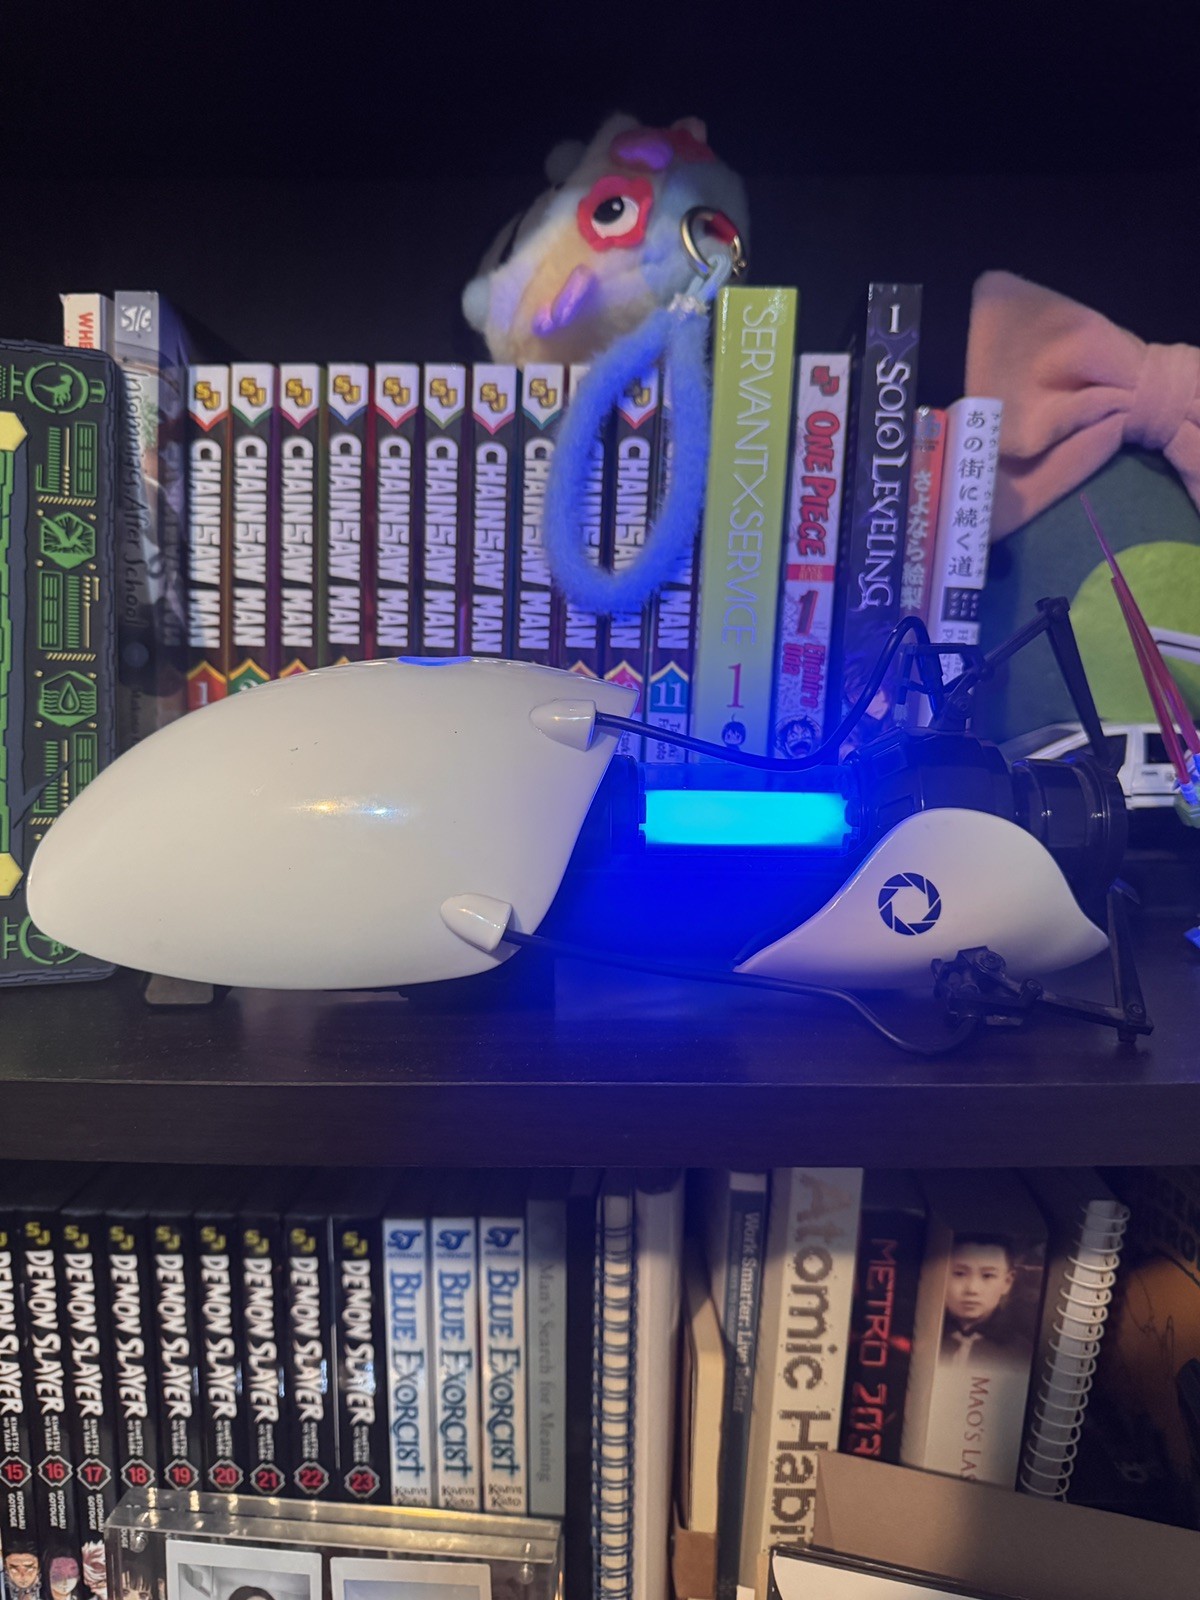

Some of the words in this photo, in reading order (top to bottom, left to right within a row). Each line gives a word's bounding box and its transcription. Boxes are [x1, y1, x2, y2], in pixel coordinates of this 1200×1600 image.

[874, 353, 911, 451] SOLO
[803, 410, 840, 473] ONE
[189, 438, 221, 585] CHAINSAW
[234, 436, 267, 584] CHAINSAW
[281, 436, 313, 584] CHAINSAW
[329, 433, 361, 580] CHAINSAW
[378, 435, 411, 584] CHAINSAW
[425, 437, 458, 585] CHAINSAW
[473, 442, 508, 590] CHAINSAW
[797, 475, 837, 558] PIECE
[947, 410, 986, 578] あの街に続く道
[857, 452, 908, 612] LEVELING
[123, 551, 147, 628] School
[189, 587, 220, 649] MAN
[233, 587, 266, 648] MAN
[281, 587, 313, 648] MAN
[328, 585, 360, 644] MAN
[377, 588, 408, 648] MAN
[424, 589, 456, 648] MAN
[519, 590, 551, 650] MAN
[471, 594, 504, 653] MAN
[653, 682, 686, 707] 11
[728, 663, 745, 708] 1
[24, 1221, 51, 1246] SJ
[63, 1225, 89, 1249] SJ
[108, 1225, 135, 1251] SJ
[155, 1225, 180, 1251] SJ
[200, 1226, 226, 1251] SJ
[243, 1228, 270, 1255] SJ
[289, 1227, 316, 1253] SJ
[342, 1231, 369, 1255] SJ
[743, 1212, 761, 1254] Work
[25, 1249, 59, 1330] DEMON
[64, 1252, 98, 1333] DEMON
[109, 1253, 142, 1335] DEMON
[156, 1253, 188, 1335] DEMON
[200, 1253, 233, 1335] DEMON
[243, 1257, 275, 1340] DEMON
[289, 1256, 321, 1339] DEMON
[341, 1259, 373, 1341] DEMON
[390, 1269, 422, 1341] BLUE
[439, 1269, 471, 1341] BLUE
[486, 1266, 519, 1339] BLUE
[538, 1261, 556, 1314] Man's
[738, 1256, 758, 1327] Smarter:
[783, 1174, 852, 1391] Atomic
[860, 1238, 898, 1369] METRO
[0, 1334, 24, 1416] SLAYER
[31, 1333, 65, 1415] SLAYER
[70, 1335, 104, 1418] SLAYER
[115, 1336, 148, 1420] SLAYER
[539, 1319, 557, 1374] Search
[736, 1330, 752, 1364] Live
[160, 1337, 193, 1420] SLAYER
[205, 1336, 238, 1421] SLAYER
[247, 1340, 279, 1423] SLAYER
[292, 1339, 324, 1422] SLAYER
[344, 1342, 377, 1425] SLAYER
[539, 1380, 557, 1405] for
[964, 1376, 990, 1442] MAO'S
[10, 1416, 20, 1452] KIMETSU
[51, 1415, 61, 1452] KIMETSU
[90, 1418, 100, 1455] KIMETSU
[390, 1347, 425, 1478] EXORCIST
[439, 1347, 473, 1479] EXORCIST
[486, 1345, 520, 1478] EXORCIST
[4, 1464, 25, 1480] 15
[45, 1463, 65, 1479] 16
[84, 1466, 103, 1482] 17
[128, 1466, 147, 1483] 18
[172, 1466, 191, 1484] 19
[215, 1466, 237, 1484] 20
[299, 1469, 324, 1487] 22
[536, 1411, 555, 1482] Meaning
[8, 1492, 18, 1528] GOTOUGE
[16, 1490, 26, 1530] KOYOHARU
[49, 1492, 58, 1527] GOTOUGE
[57, 1490, 67, 1530] KOYOHARU
[256, 1471, 278, 1488] 21
[350, 1473, 376, 1492] 23
[87, 1495, 97, 1530] GOTOUGE
